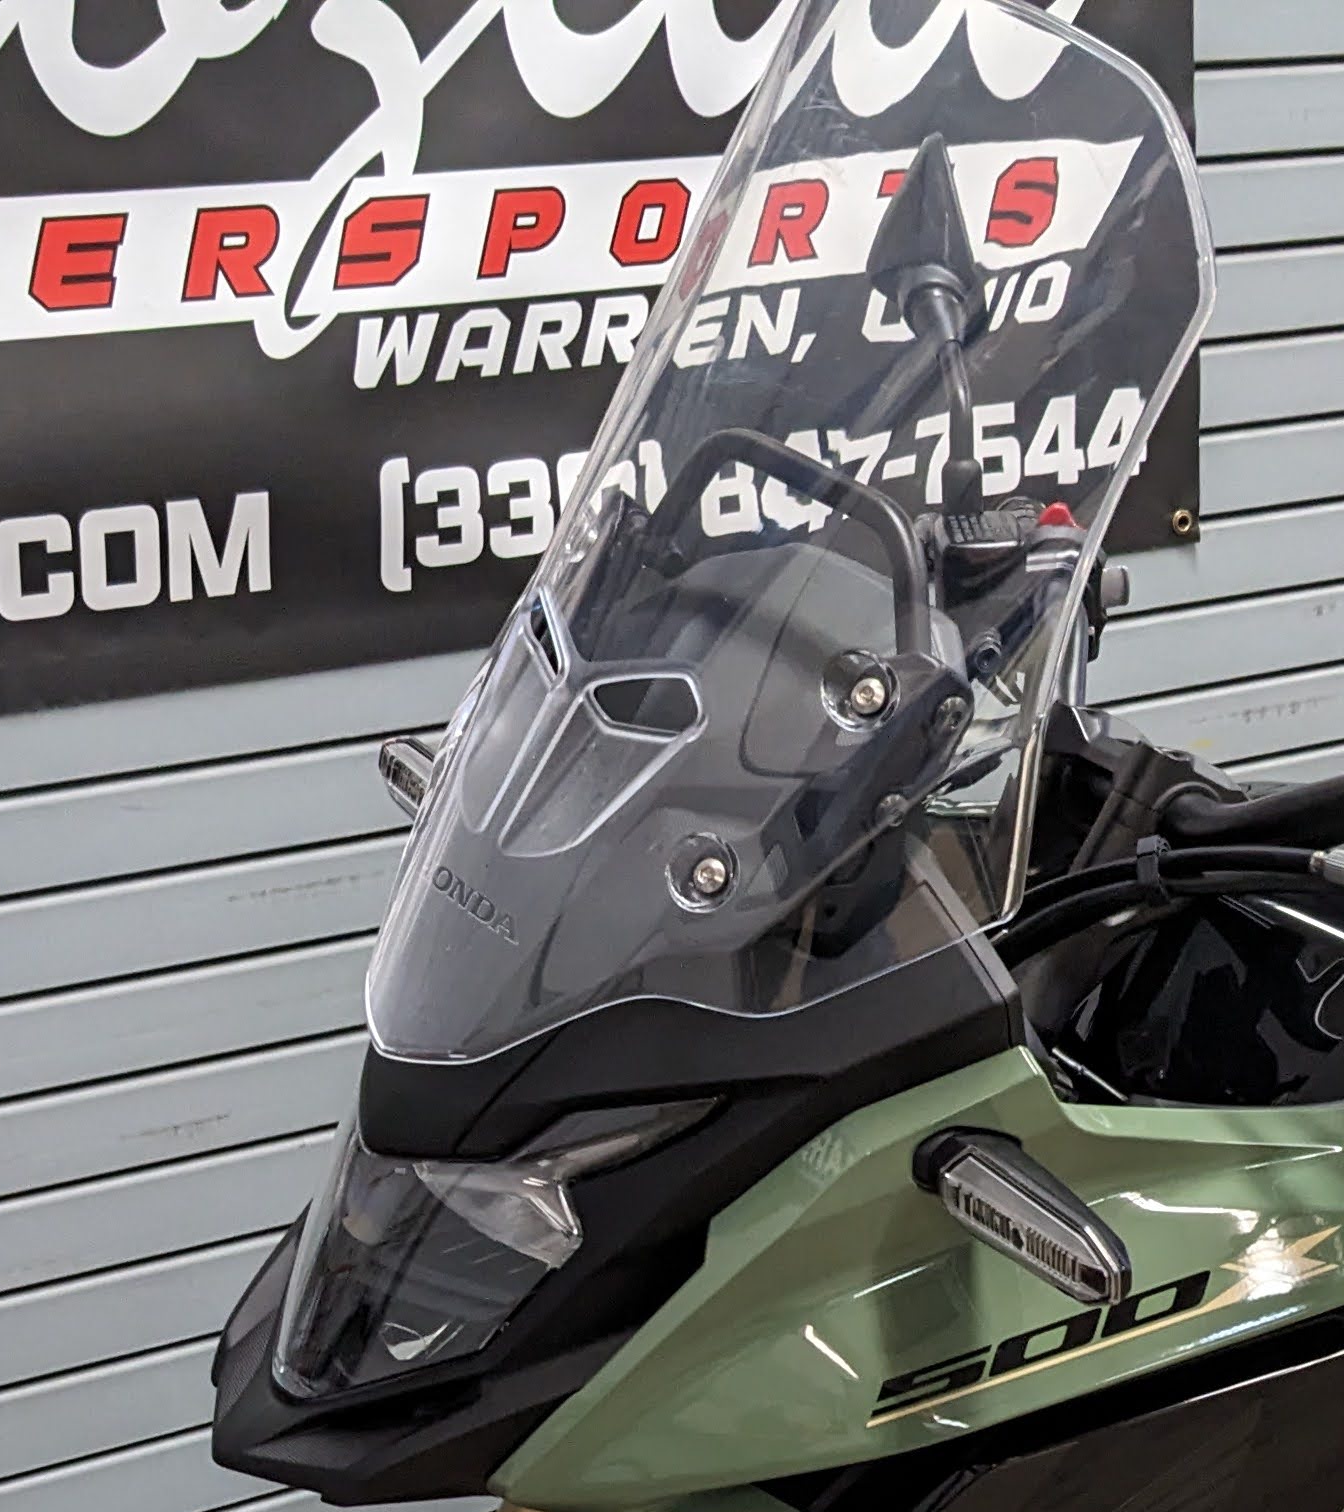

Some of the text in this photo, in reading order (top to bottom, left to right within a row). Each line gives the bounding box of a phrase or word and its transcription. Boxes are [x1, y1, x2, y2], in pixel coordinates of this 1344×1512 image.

[353, 260, 1072, 389] WARREN, IO
[431, 865, 520, 946] ONDA
